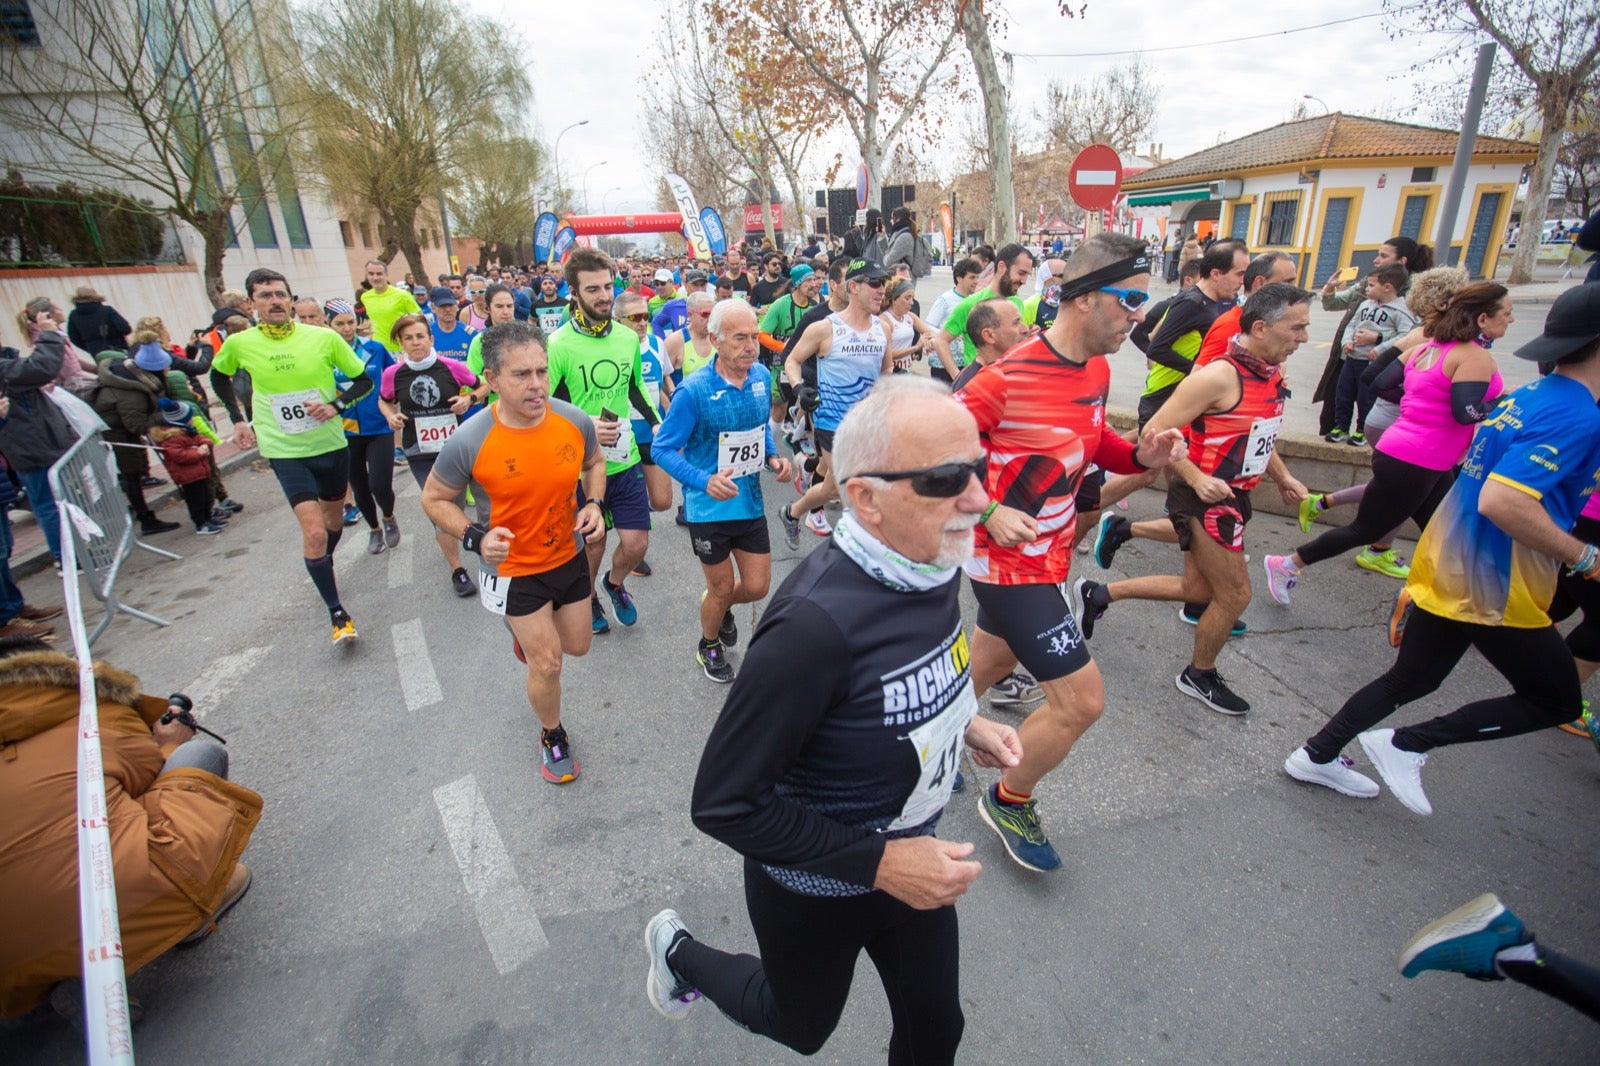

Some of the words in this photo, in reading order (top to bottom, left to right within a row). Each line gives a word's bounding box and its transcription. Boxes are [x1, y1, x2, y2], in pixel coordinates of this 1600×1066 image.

[1361, 307, 1389, 325] GAP
[841, 345, 883, 353] MARACENA
[281, 404, 310, 421] 86
[728, 442, 760, 463] 783
[104, 980, 131, 1059] DEPORTES
